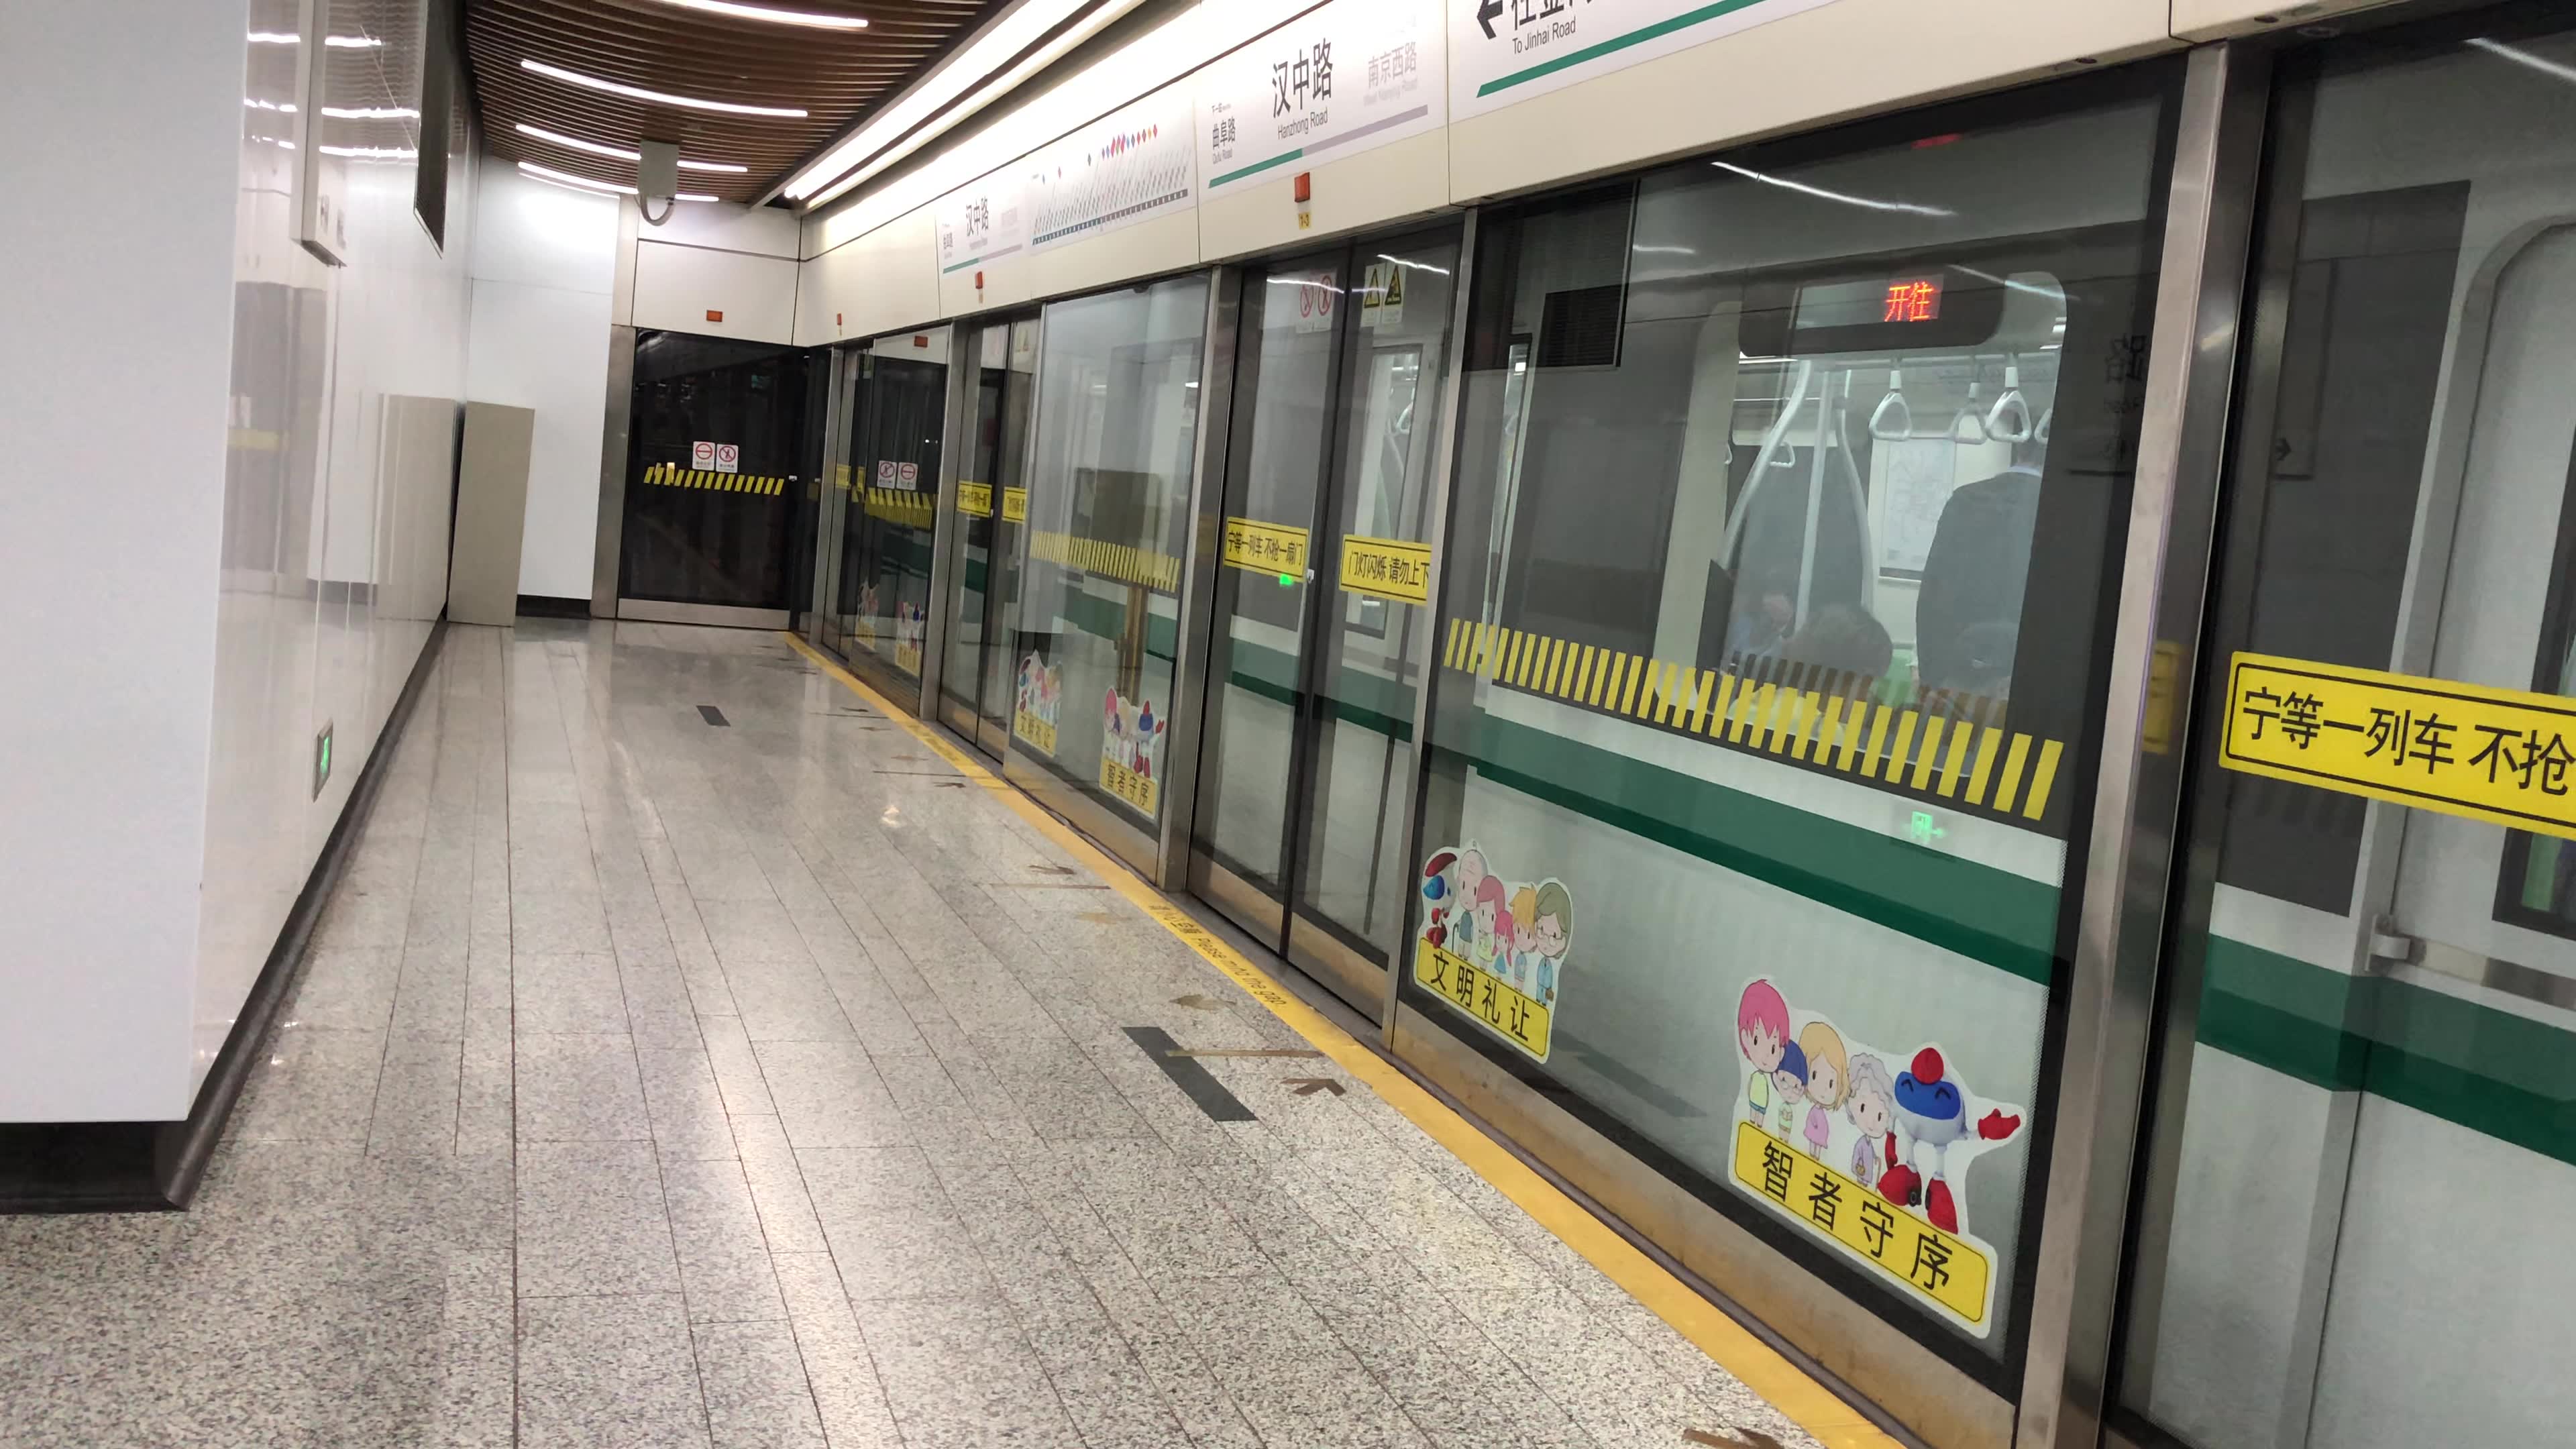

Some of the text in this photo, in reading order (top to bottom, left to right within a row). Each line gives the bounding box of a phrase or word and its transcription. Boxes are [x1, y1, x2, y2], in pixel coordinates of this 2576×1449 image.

[1512, 16, 1576, 54] To Jinhai Road
[1272, 38, 1333, 118] 汉中路
[1368, 42, 1417, 89] 南京西路
[1212, 116, 1236, 150] 曲阜路
[1277, 106, 1328, 140] Hanzhong Road
[966, 196, 989, 237] 汉中路
[1884, 281, 1935, 322] 开往
[1228, 530, 1303, 566] 宁等一列车 不抢一扇门
[1348, 550, 1430, 588] 门灯闪烁 请勿上下
[2243, 686, 2576, 796] 宁等一列车 不抢
[1430, 951, 1529, 1042] 文明礼让
[1762, 1140, 1953, 1291] 智者守序
